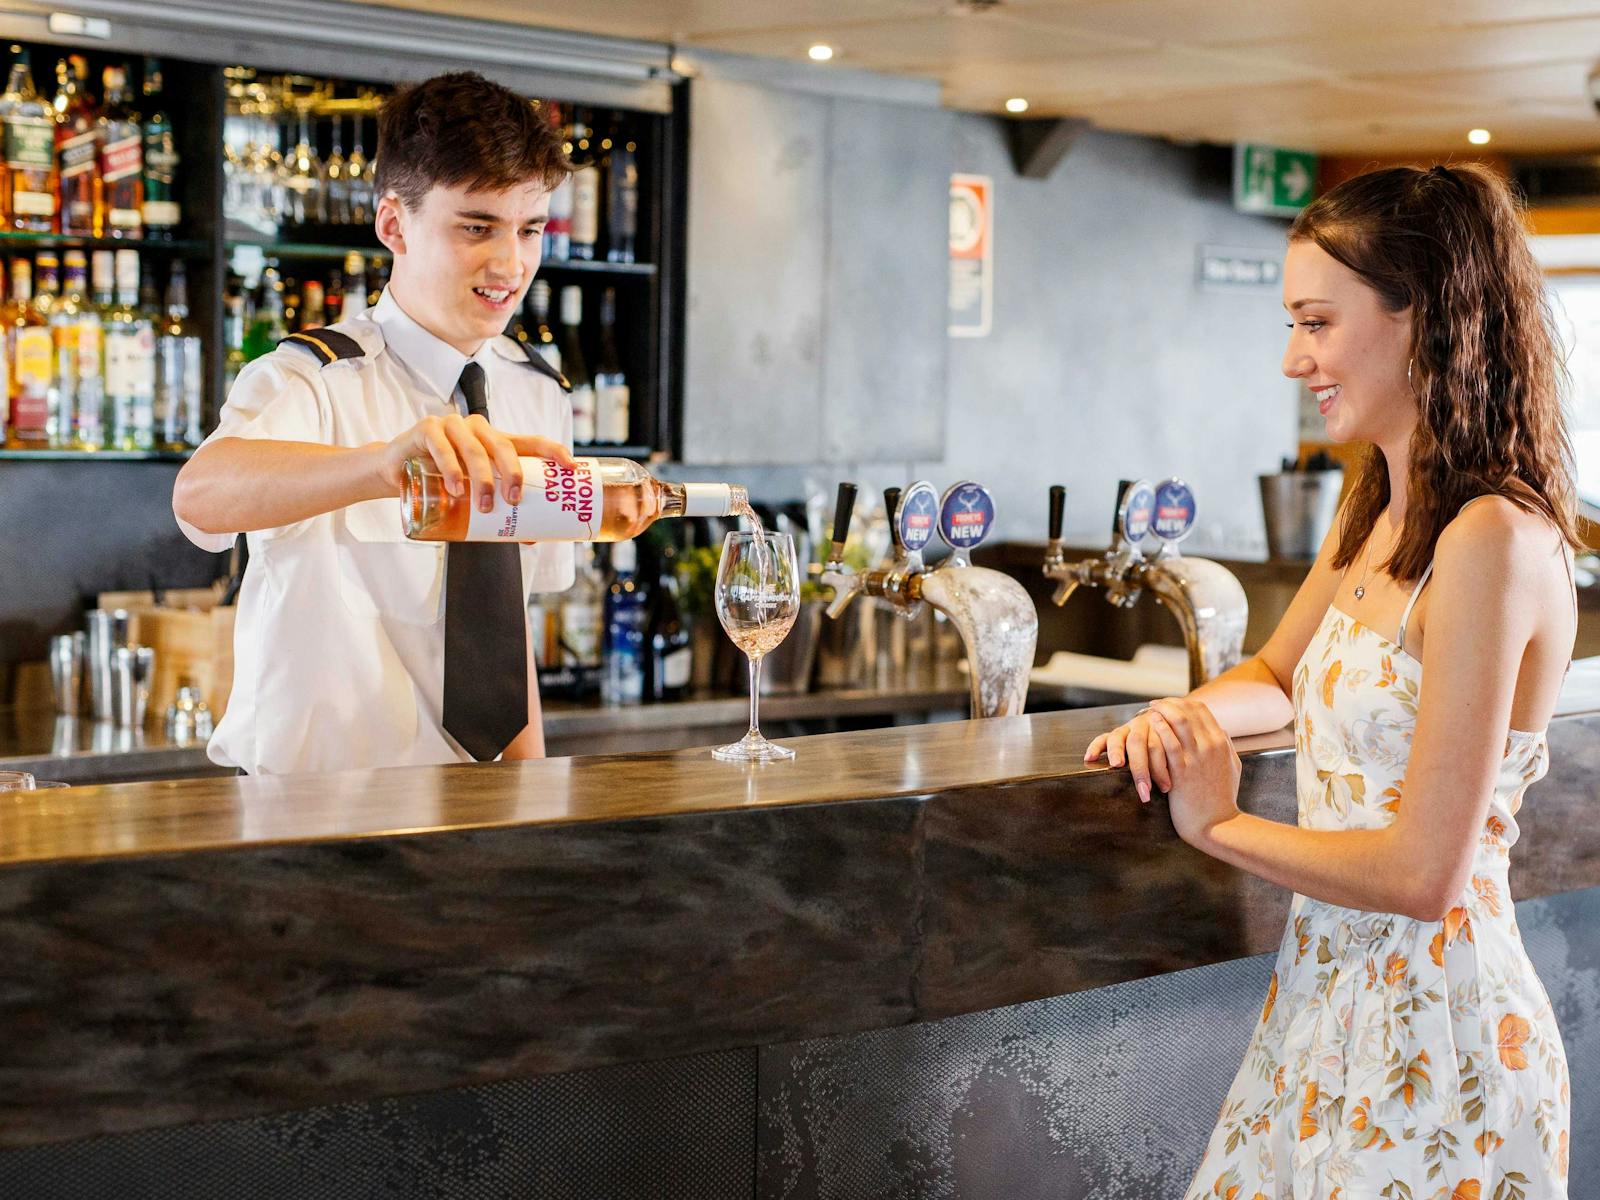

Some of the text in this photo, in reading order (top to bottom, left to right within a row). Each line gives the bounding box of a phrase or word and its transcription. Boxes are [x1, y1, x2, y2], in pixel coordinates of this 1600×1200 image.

[560, 467, 577, 512] ROKE
[576, 461, 593, 523] BEYOND
[905, 527, 930, 541] NEW
[951, 525, 985, 539] NEW
